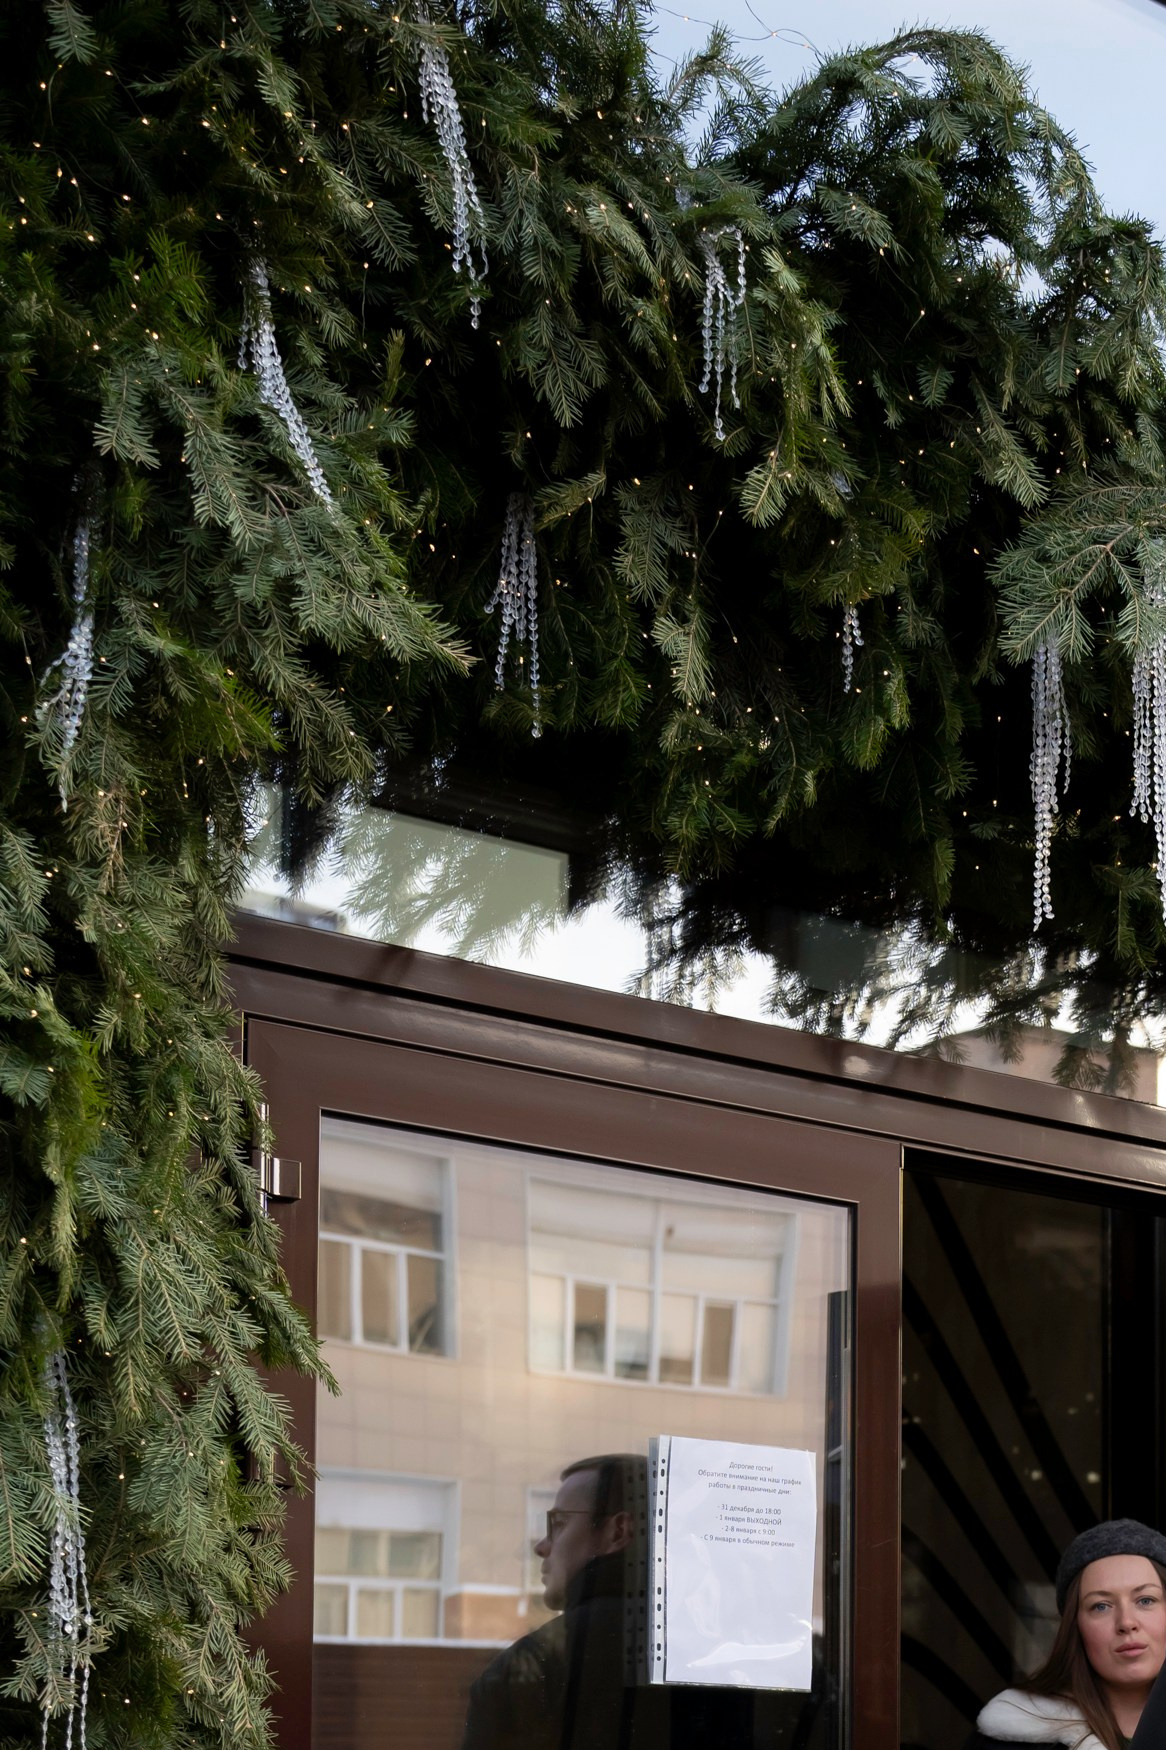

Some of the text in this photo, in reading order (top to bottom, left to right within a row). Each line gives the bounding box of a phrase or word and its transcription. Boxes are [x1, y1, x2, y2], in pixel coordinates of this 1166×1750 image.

[729, 1462, 754, 1471] Дорогие
[698, 1469, 727, 1479] Обратите
[737, 1485, 777, 1494] праздничные
[747, 1517, 782, 1525] ВЫХОДНОЙ
[743, 1537, 770, 1546] обычном
